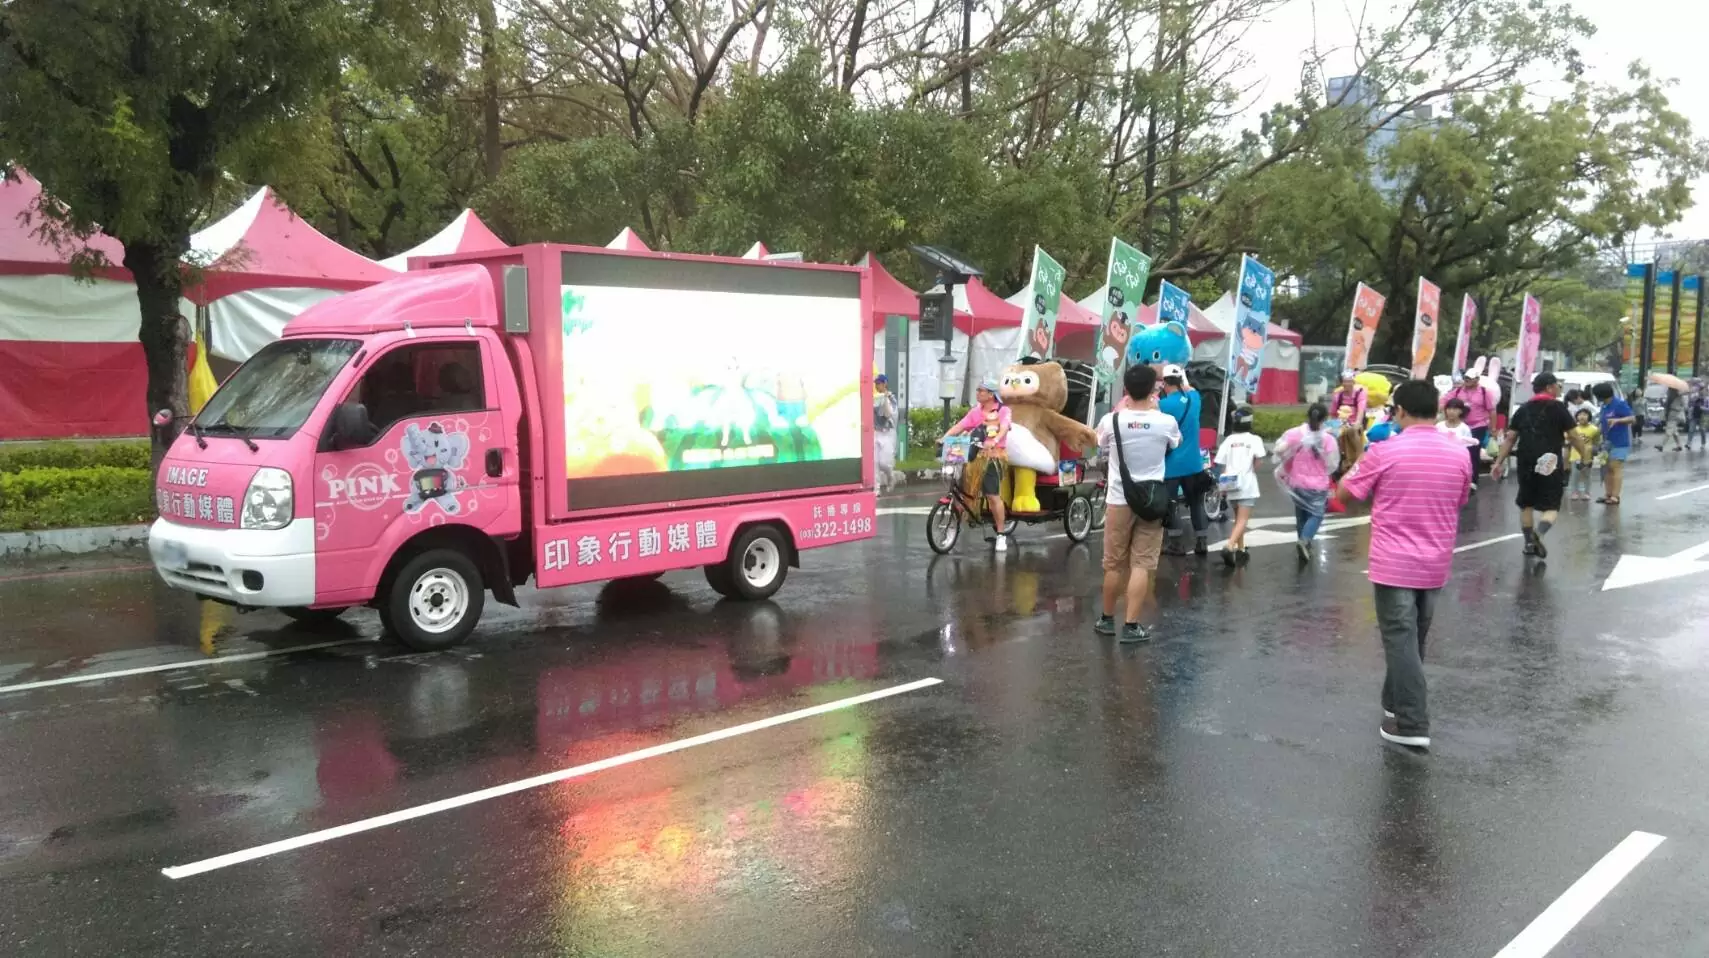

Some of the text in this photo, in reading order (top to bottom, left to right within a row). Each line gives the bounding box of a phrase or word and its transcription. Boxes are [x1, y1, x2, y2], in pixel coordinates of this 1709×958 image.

[166, 466, 209, 487] IMAGE
[327, 473, 401, 499] PINK
[543, 520, 718, 570] 印象行動媒體
